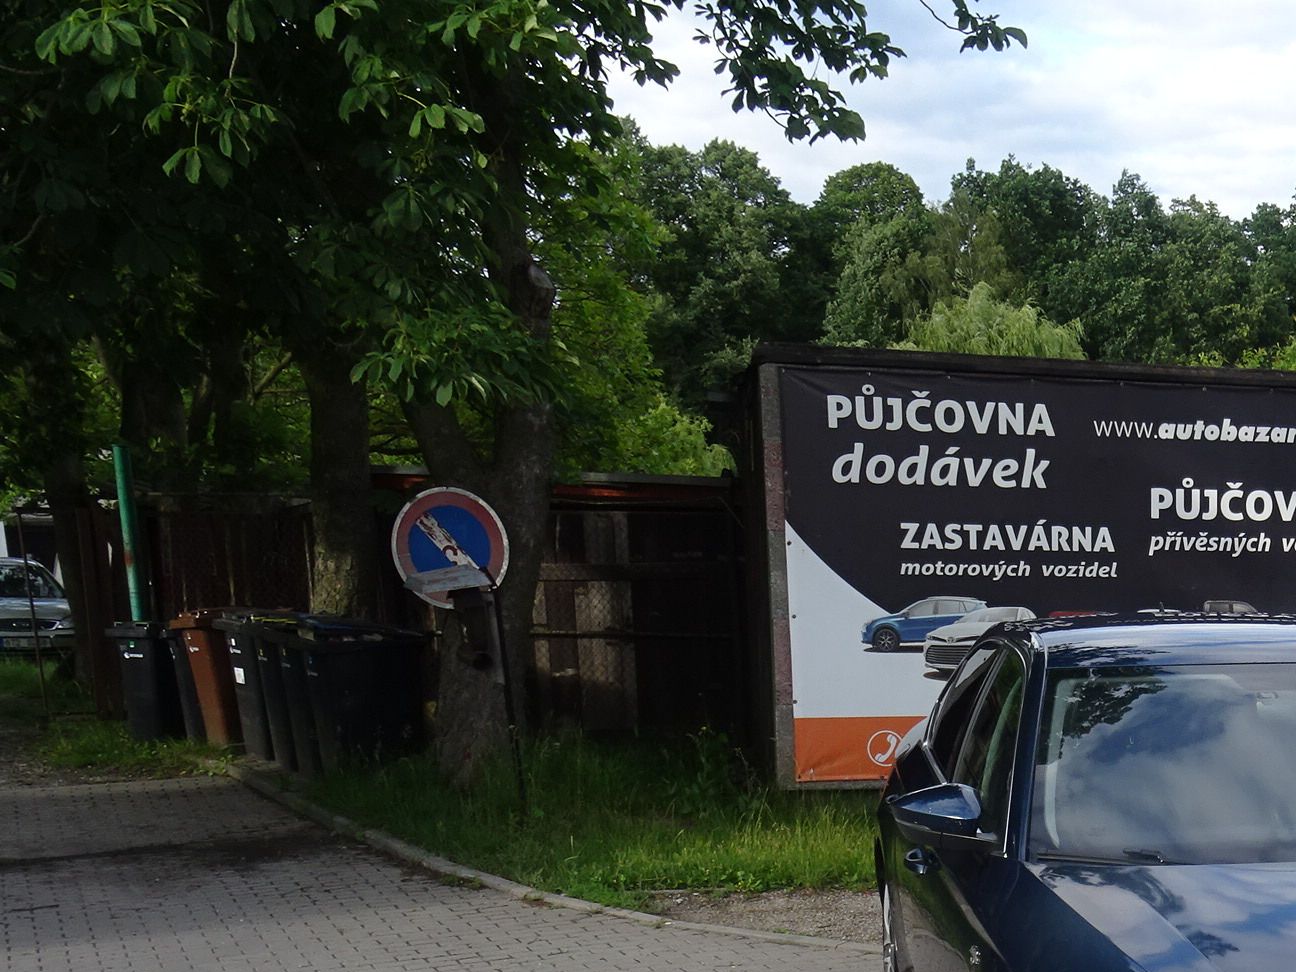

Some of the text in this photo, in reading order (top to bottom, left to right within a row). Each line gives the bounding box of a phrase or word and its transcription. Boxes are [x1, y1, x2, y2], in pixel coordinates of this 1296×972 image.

[827, 384, 1056, 437] PŮJČOVNA
[832, 442, 1050, 489] dodávek
[900, 519, 1116, 553] ZASTAVÁRNA
[1148, 531, 1271, 558] přívěsných
[899, 560, 1118, 582] motorových vozidel
